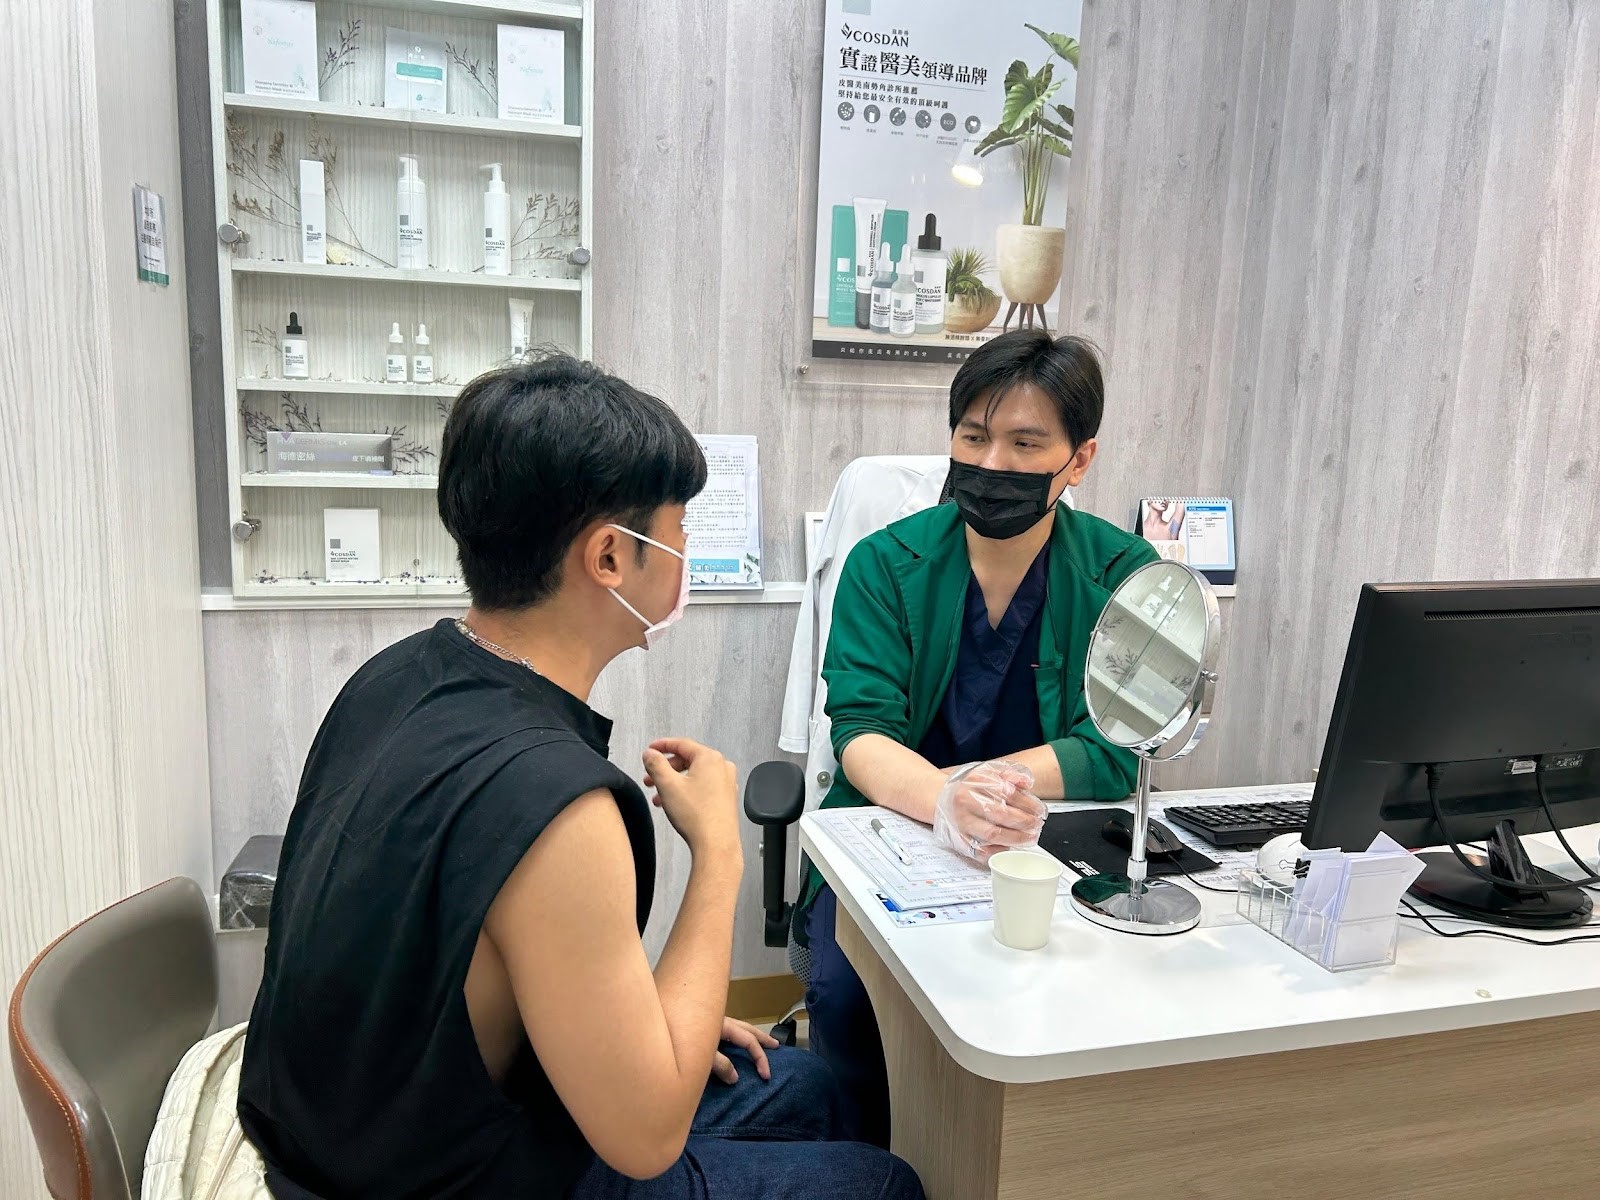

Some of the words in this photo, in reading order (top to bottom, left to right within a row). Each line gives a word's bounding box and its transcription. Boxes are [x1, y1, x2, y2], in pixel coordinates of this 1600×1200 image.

[853, 30, 910, 48] COSDAN
[839, 46, 988, 86] 實證醫美領導品牌
[277, 451, 316, 463] 海德密絲
